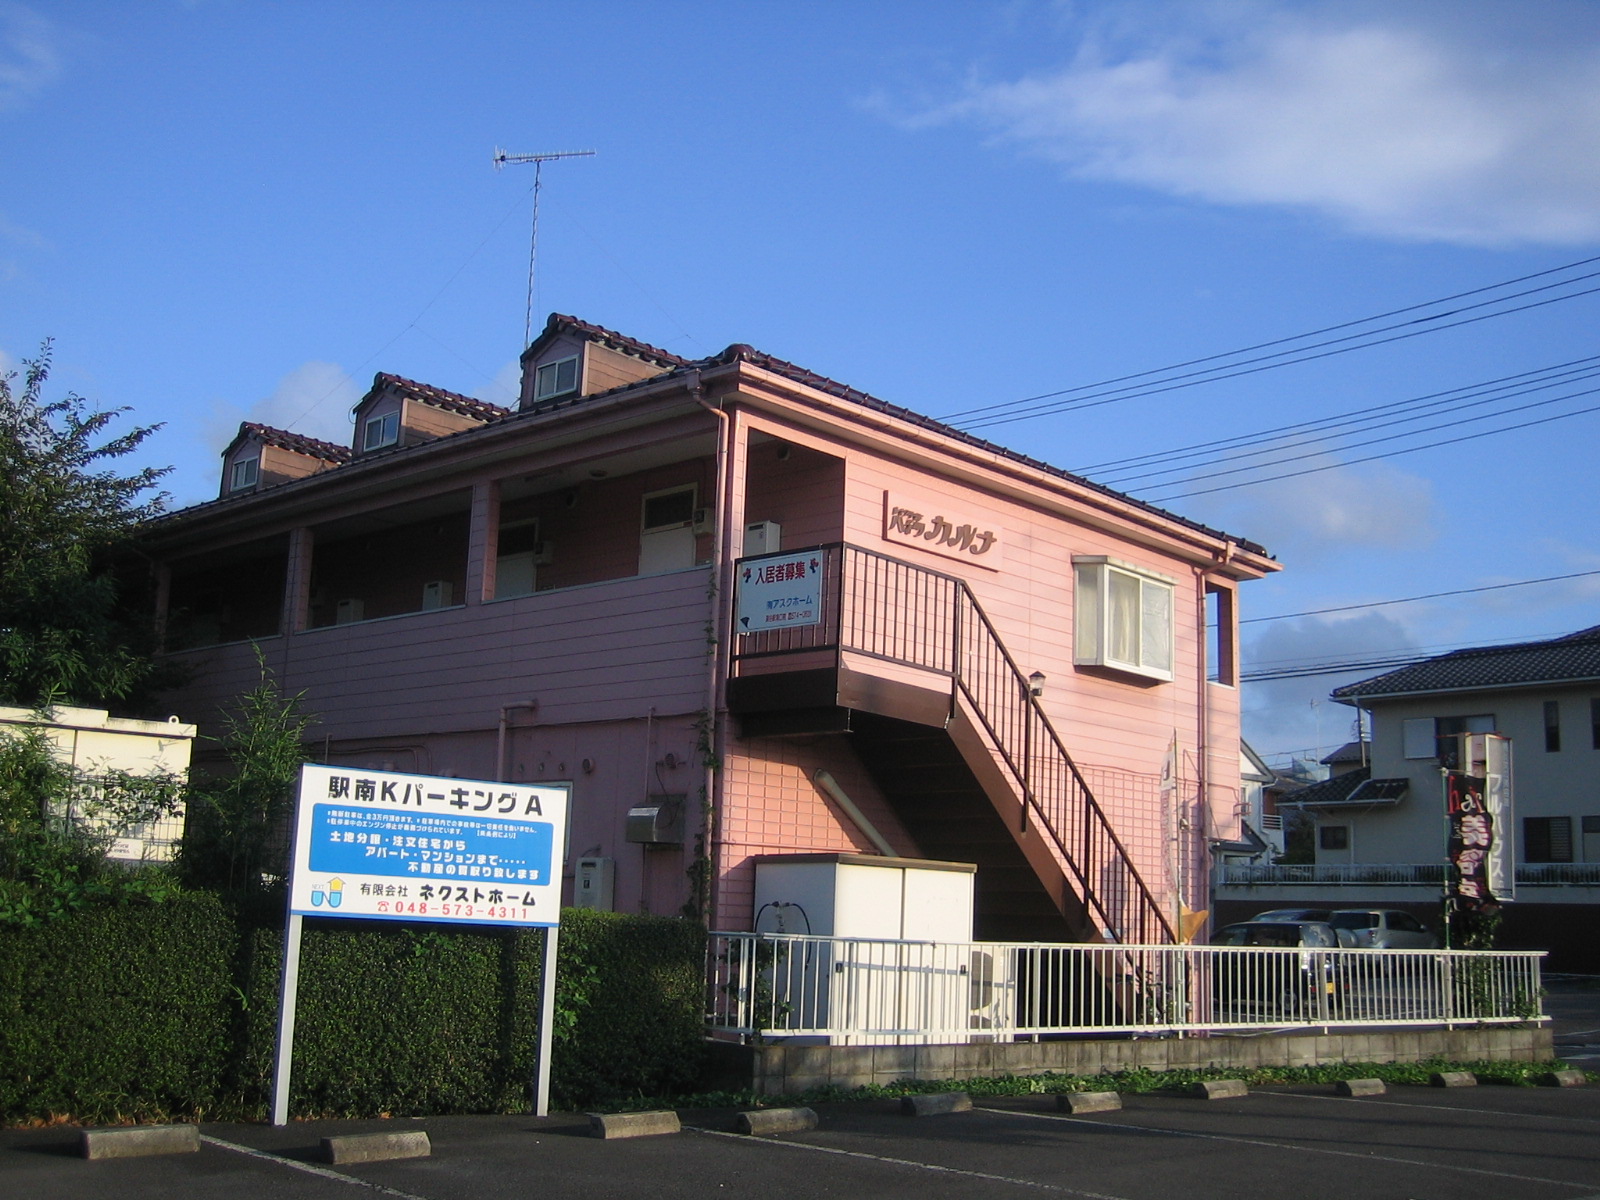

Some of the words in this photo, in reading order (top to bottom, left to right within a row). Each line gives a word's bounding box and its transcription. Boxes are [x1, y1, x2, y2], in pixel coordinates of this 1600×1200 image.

[754, 561, 806, 585] 入居者募集
[327, 775, 544, 816] 駅南KパーキングA
[1489, 774, 1504, 878] フルハウス
[330, 830, 467, 851] 土地分譲・注文住宅から
[407, 861, 539, 881] 不動産の買取り致します
[359, 881, 409, 898] 有限会社
[418, 883, 538, 907] ネクストホーム
[394, 900, 528, 920] 048-573-4311
